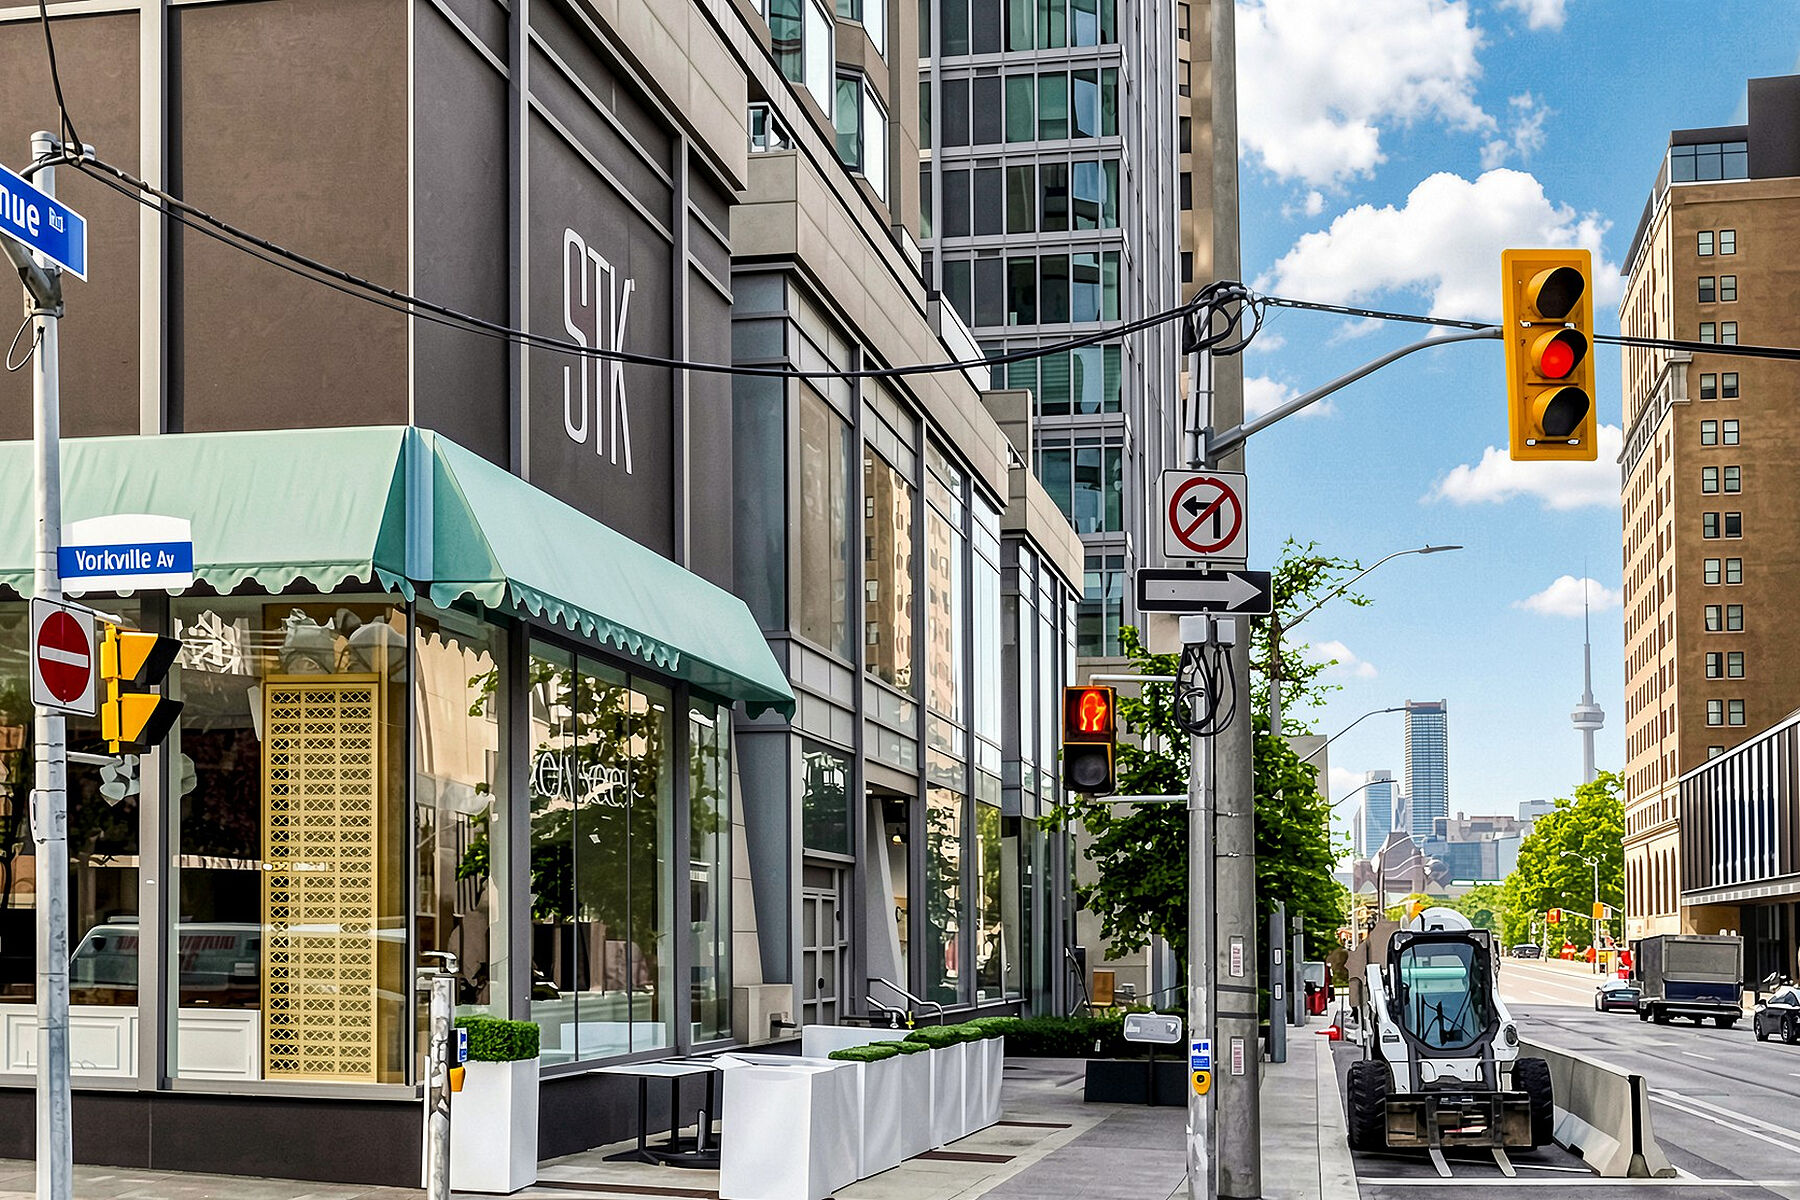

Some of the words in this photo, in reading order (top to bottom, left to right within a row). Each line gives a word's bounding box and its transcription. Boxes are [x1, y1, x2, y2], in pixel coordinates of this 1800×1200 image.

[563, 227, 635, 475] STK
[75, 548, 152, 571] Yorkville
[156, 550, 175, 568] Av
